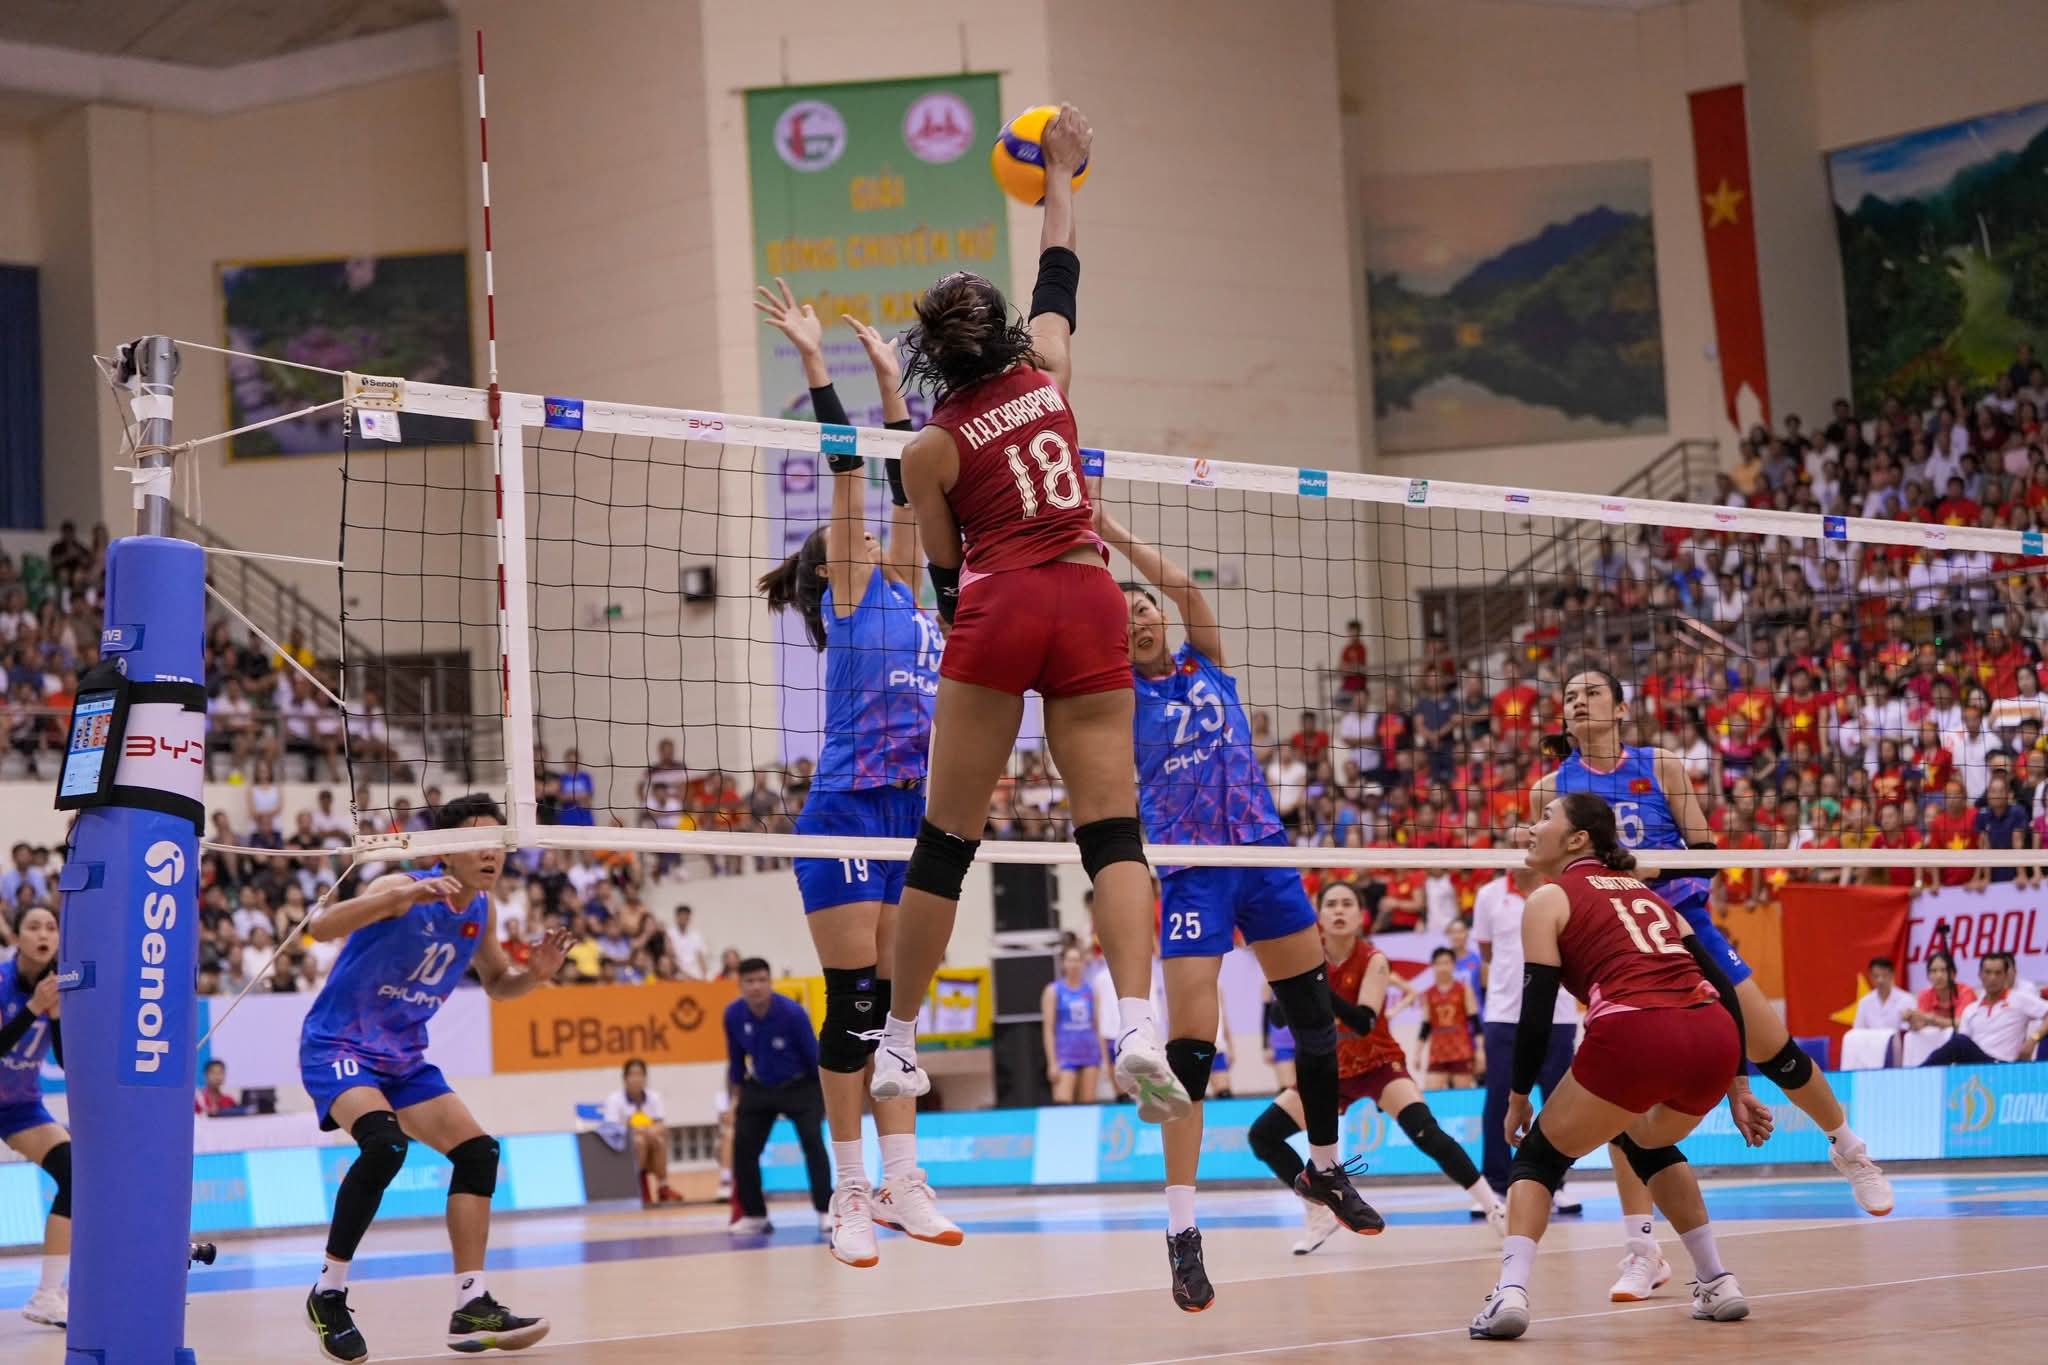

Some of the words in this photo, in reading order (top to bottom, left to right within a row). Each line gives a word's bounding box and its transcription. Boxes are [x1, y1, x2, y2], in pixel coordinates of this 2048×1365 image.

[370, 379, 398, 388] Senoh
[821, 433, 856, 443] PHUMY
[1004, 430, 1082, 520] 18
[890, 671, 938, 695] PHUM
[1164, 680, 1224, 749] 25
[125, 735, 203, 765] BYD
[838, 858, 869, 883] 19
[1169, 912, 1202, 941] 25
[1609, 898, 1691, 954] 12
[1907, 907, 2048, 962] GARBOL
[406, 942, 456, 986] 10
[135, 892, 176, 1073] Senoh
[530, 1015, 670, 1058] LPBank
[332, 1058, 359, 1081] 10
